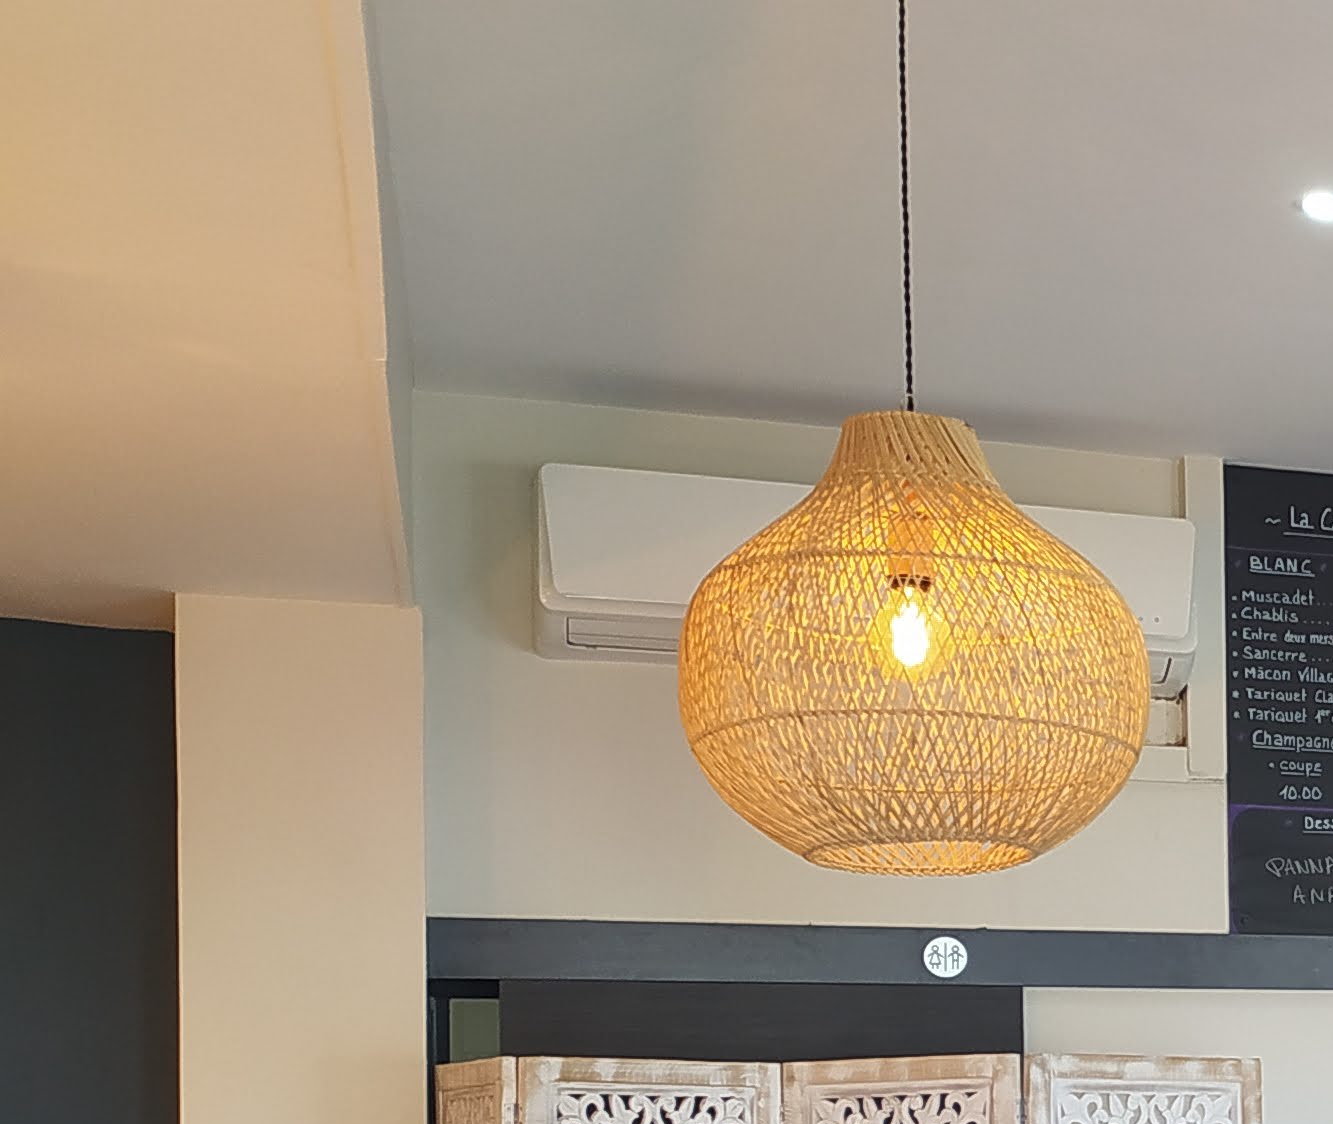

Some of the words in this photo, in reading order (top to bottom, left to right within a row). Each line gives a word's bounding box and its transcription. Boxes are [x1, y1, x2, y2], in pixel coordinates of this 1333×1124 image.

[1290, 505, 1314, 530] La
[1250, 556, 1312, 573] BLANC
[1242, 589, 1314, 605] Muscadet
[1241, 607, 1299, 622] Chablis
[1243, 627, 1277, 642] Entre
[1284, 629, 1305, 643] deux
[1243, 646, 1307, 662] Sancerre
[1247, 688, 1306, 702] Tariquet
[1248, 708, 1307, 723] Tariquet
[1279, 786, 1322, 800] 10.00
